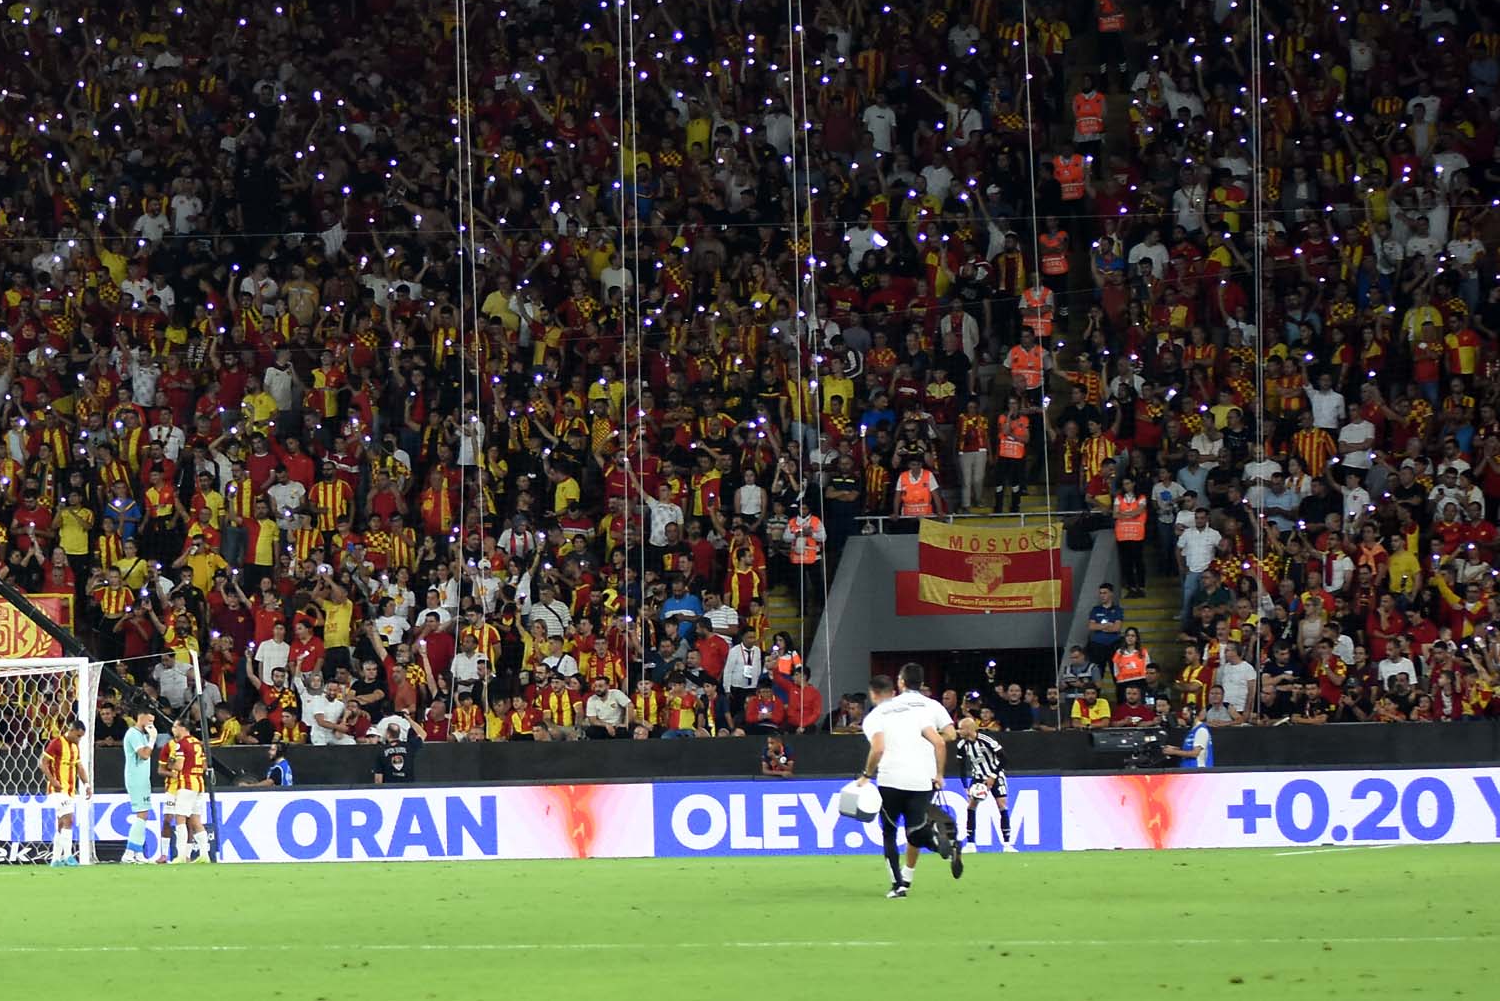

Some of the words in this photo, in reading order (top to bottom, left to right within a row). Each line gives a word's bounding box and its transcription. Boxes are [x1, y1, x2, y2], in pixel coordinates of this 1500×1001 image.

[949, 533, 1030, 553] MÖSYÖ
[275, 795, 499, 861] ORAN
[1227, 776, 1456, 842] +0.20
